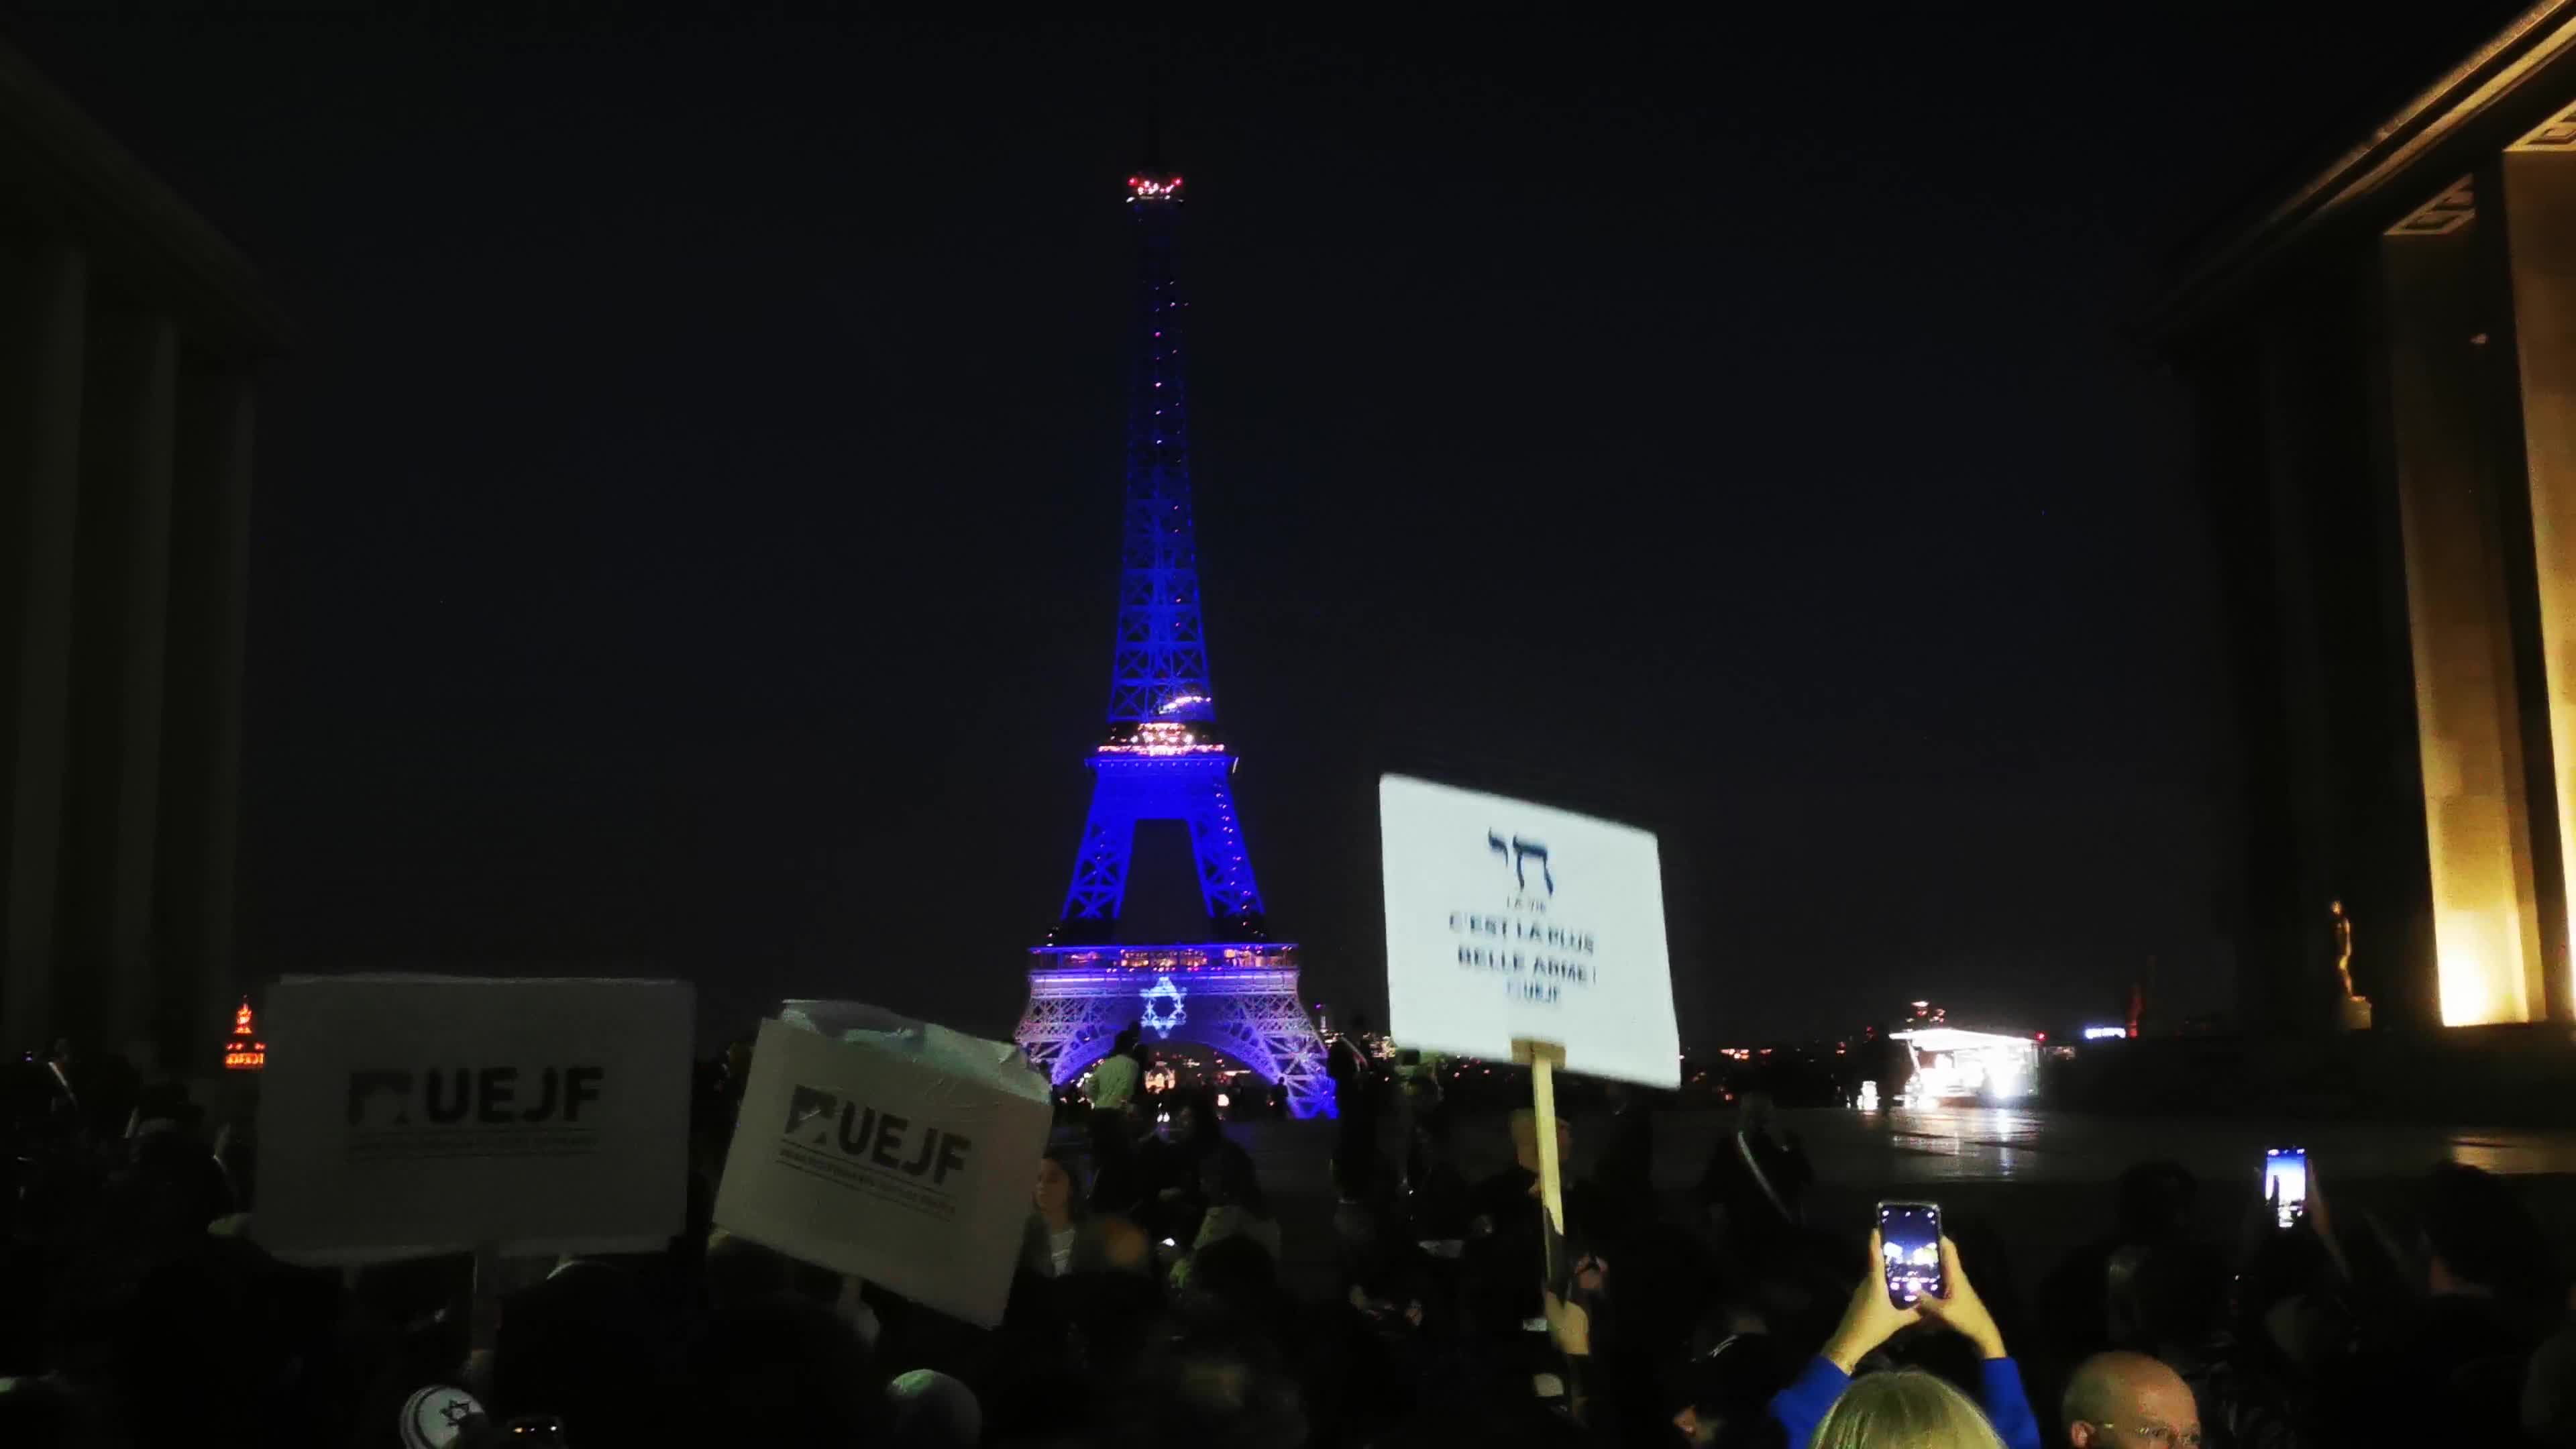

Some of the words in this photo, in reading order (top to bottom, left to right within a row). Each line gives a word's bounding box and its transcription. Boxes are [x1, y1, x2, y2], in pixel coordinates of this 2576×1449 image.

[1458, 945, 1524, 970] BELLE
[426, 1066, 604, 1124] UEJF
[839, 1100, 972, 1185] UEJF
